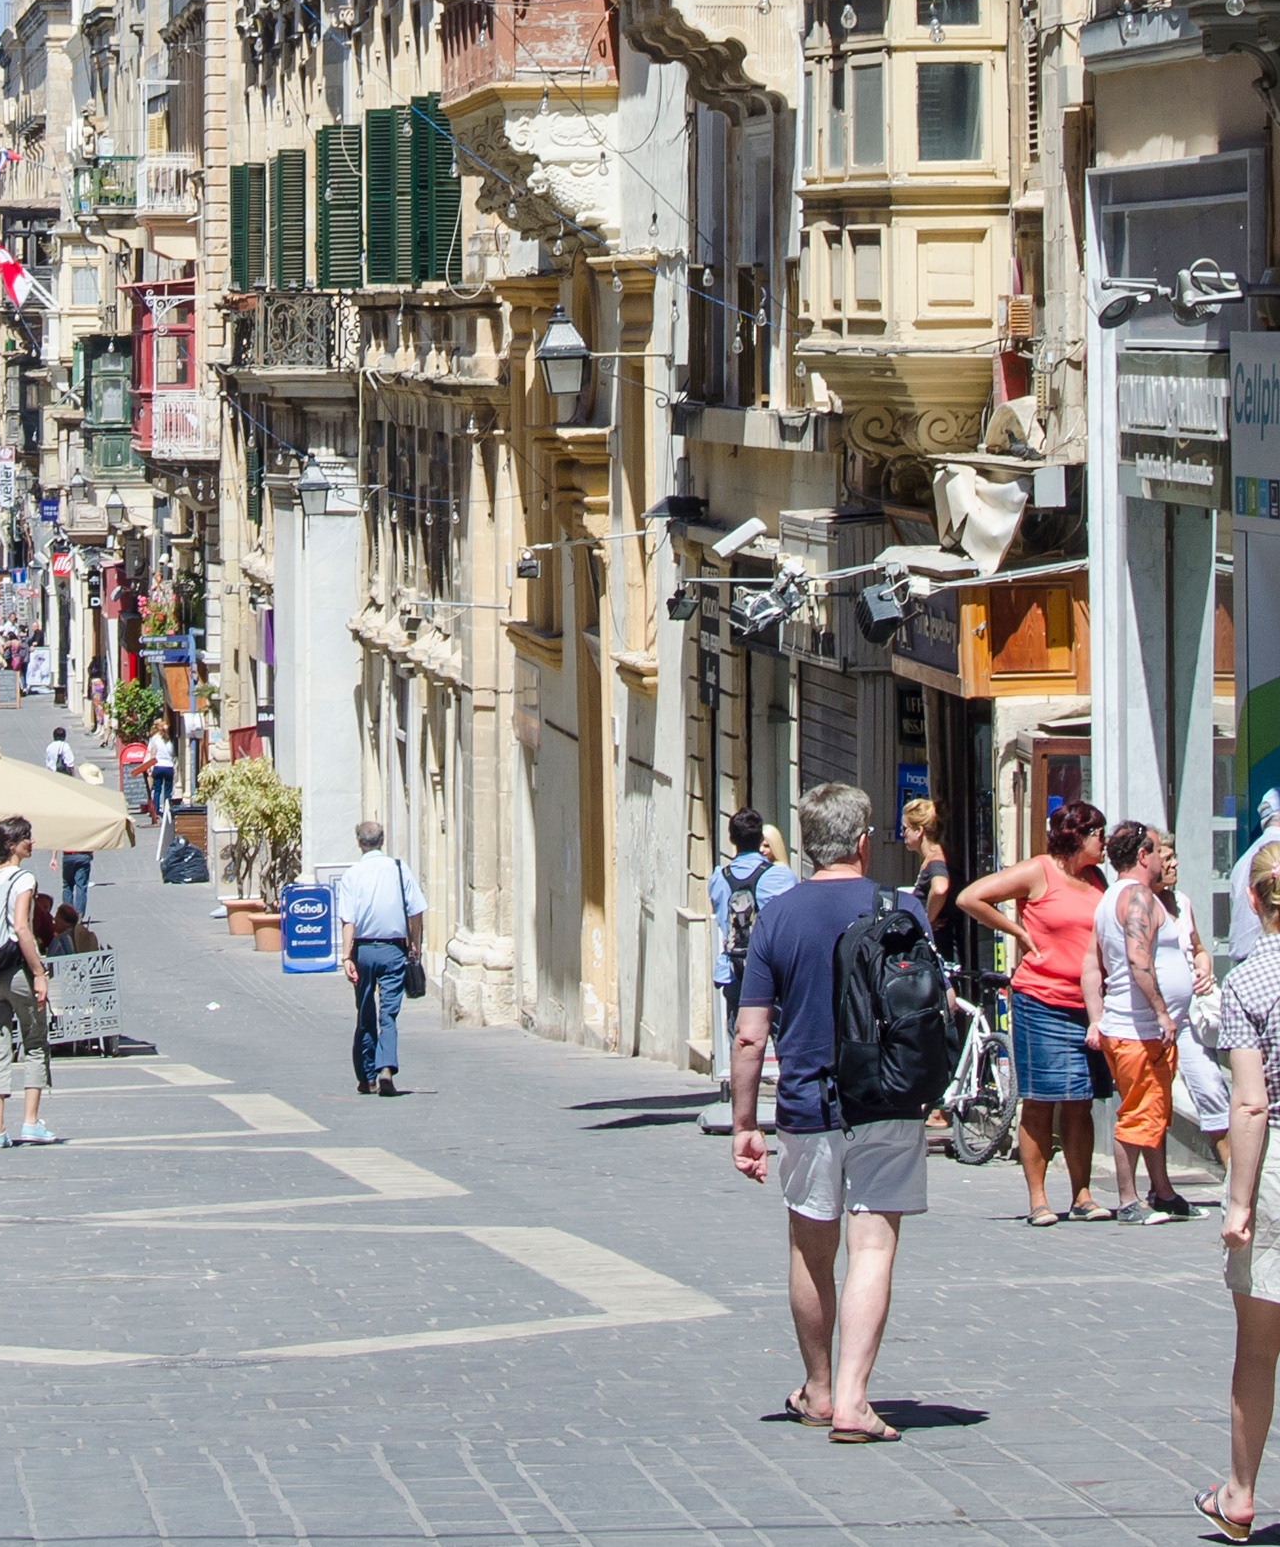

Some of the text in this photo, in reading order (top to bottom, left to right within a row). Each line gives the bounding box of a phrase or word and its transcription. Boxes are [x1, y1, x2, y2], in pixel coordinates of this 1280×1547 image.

[53, 556, 72, 574] illy
[293, 903, 323, 914] Scholl
[295, 924, 323, 934] Gabor
